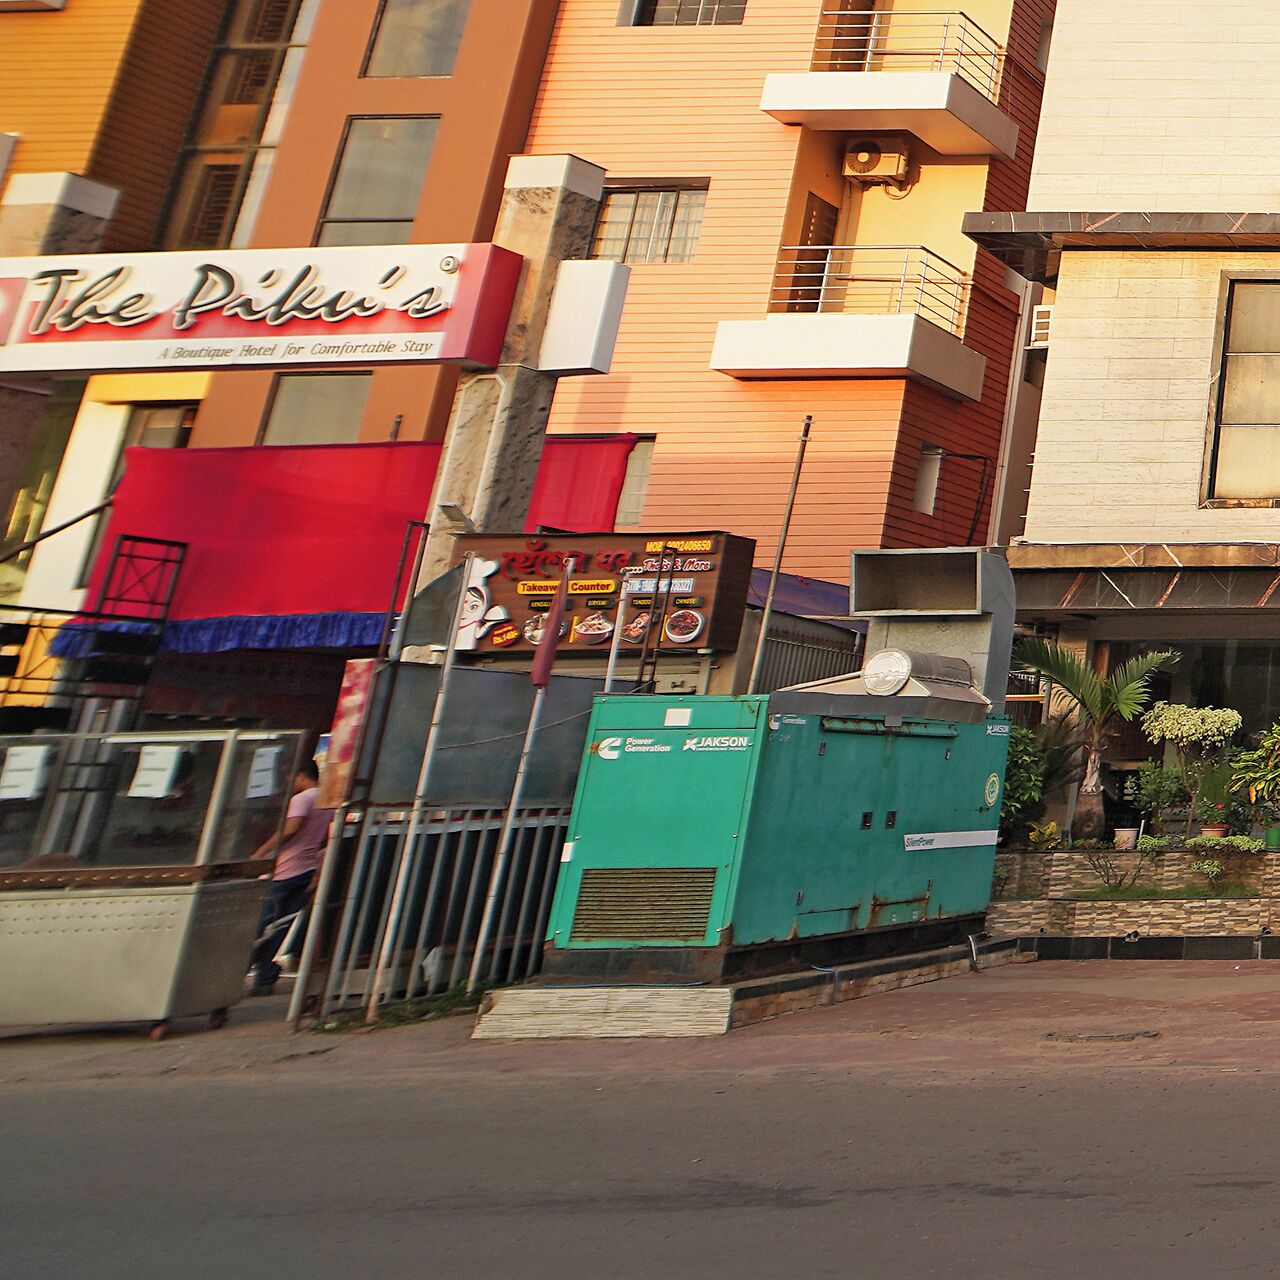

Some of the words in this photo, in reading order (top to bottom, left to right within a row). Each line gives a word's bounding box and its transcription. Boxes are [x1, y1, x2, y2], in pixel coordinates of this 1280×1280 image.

[29, 266, 160, 335] The
[173, 263, 455, 329] Piku's
[160, 348, 170, 359] A
[172, 345, 234, 361] Boutique
[238, 344, 276, 357] Hotel
[280, 342, 305, 358] for
[310, 340, 397, 356] Comfortable
[401, 339, 435, 355] Stay
[571, 582, 612, 591] Counter
[697, 736, 748, 746] JAKSON
